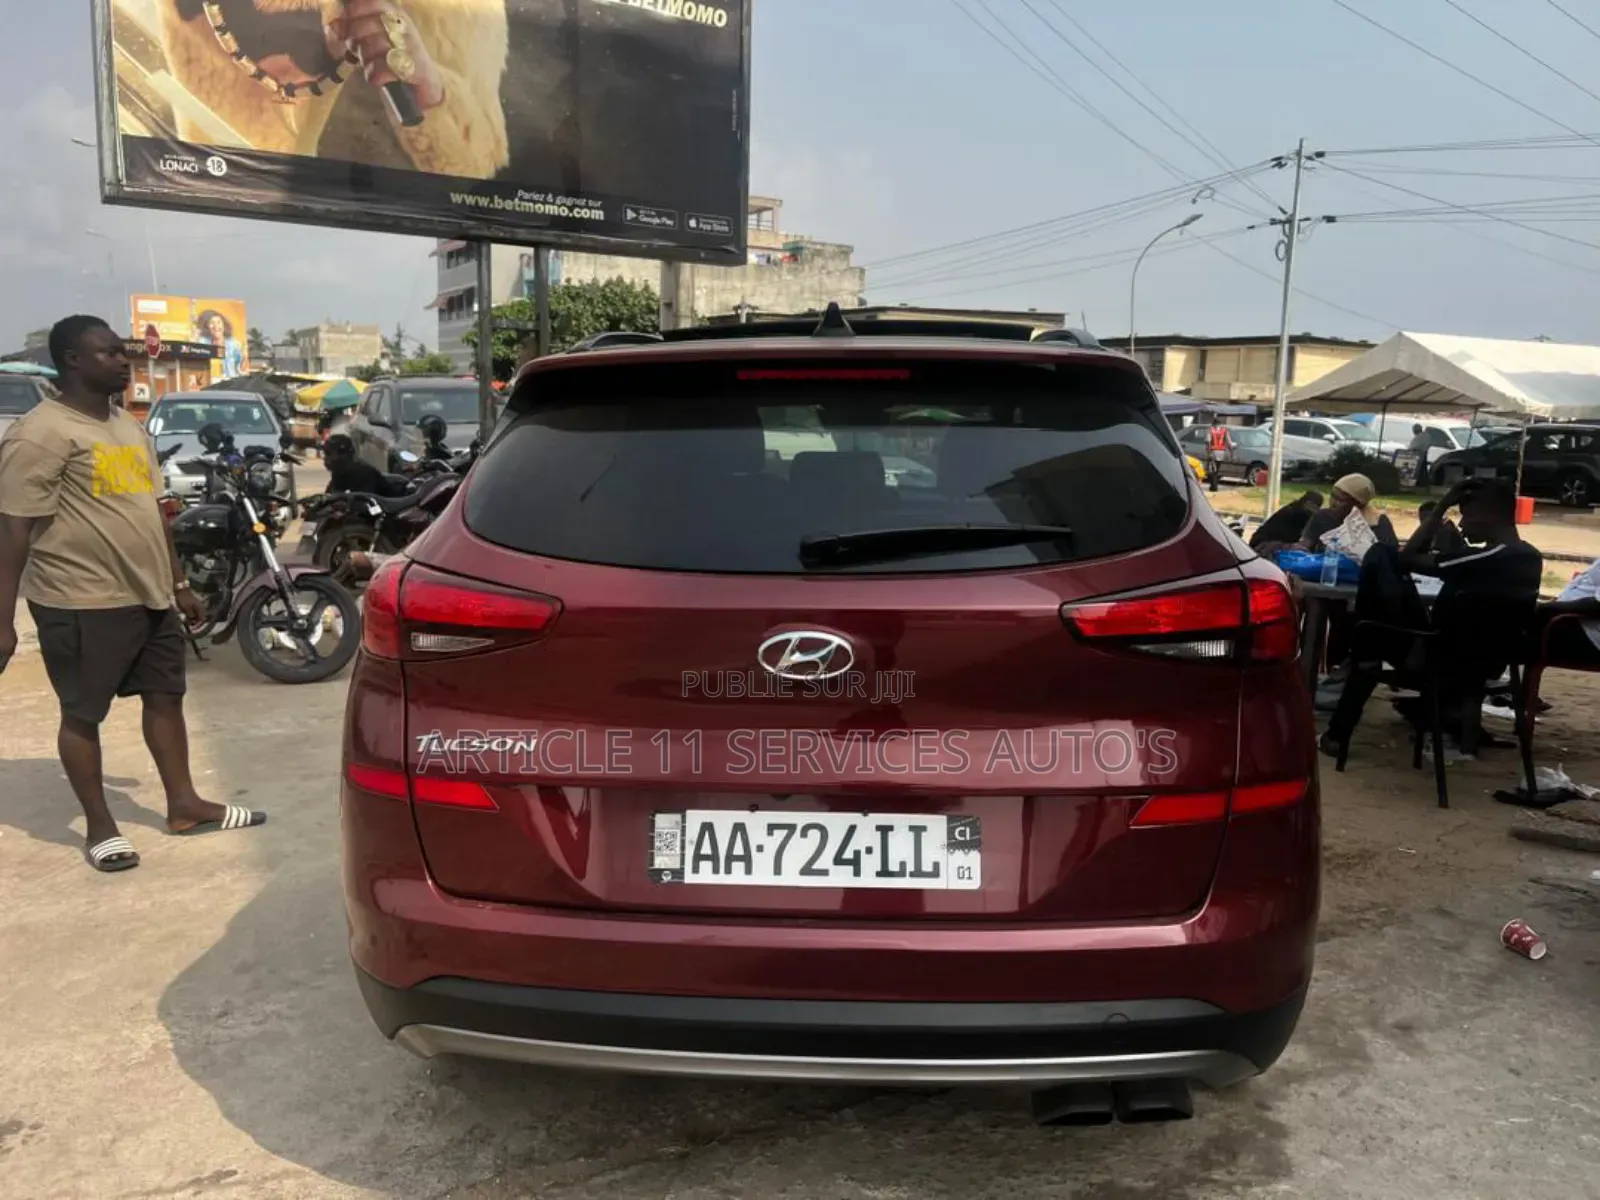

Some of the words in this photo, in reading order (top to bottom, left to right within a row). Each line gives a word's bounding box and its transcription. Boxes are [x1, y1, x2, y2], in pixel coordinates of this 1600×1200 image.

[160, 159, 198, 173] LONACI
[450, 192, 604, 221] www.betmomo.com
[517, 189, 545, 202] Pariez
[546, 193, 554, 203] &
[588, 199, 603, 208] sur
[416, 733, 538, 754] TUCSON
[954, 826, 970, 841] CI
[956, 865, 974, 881] 01
